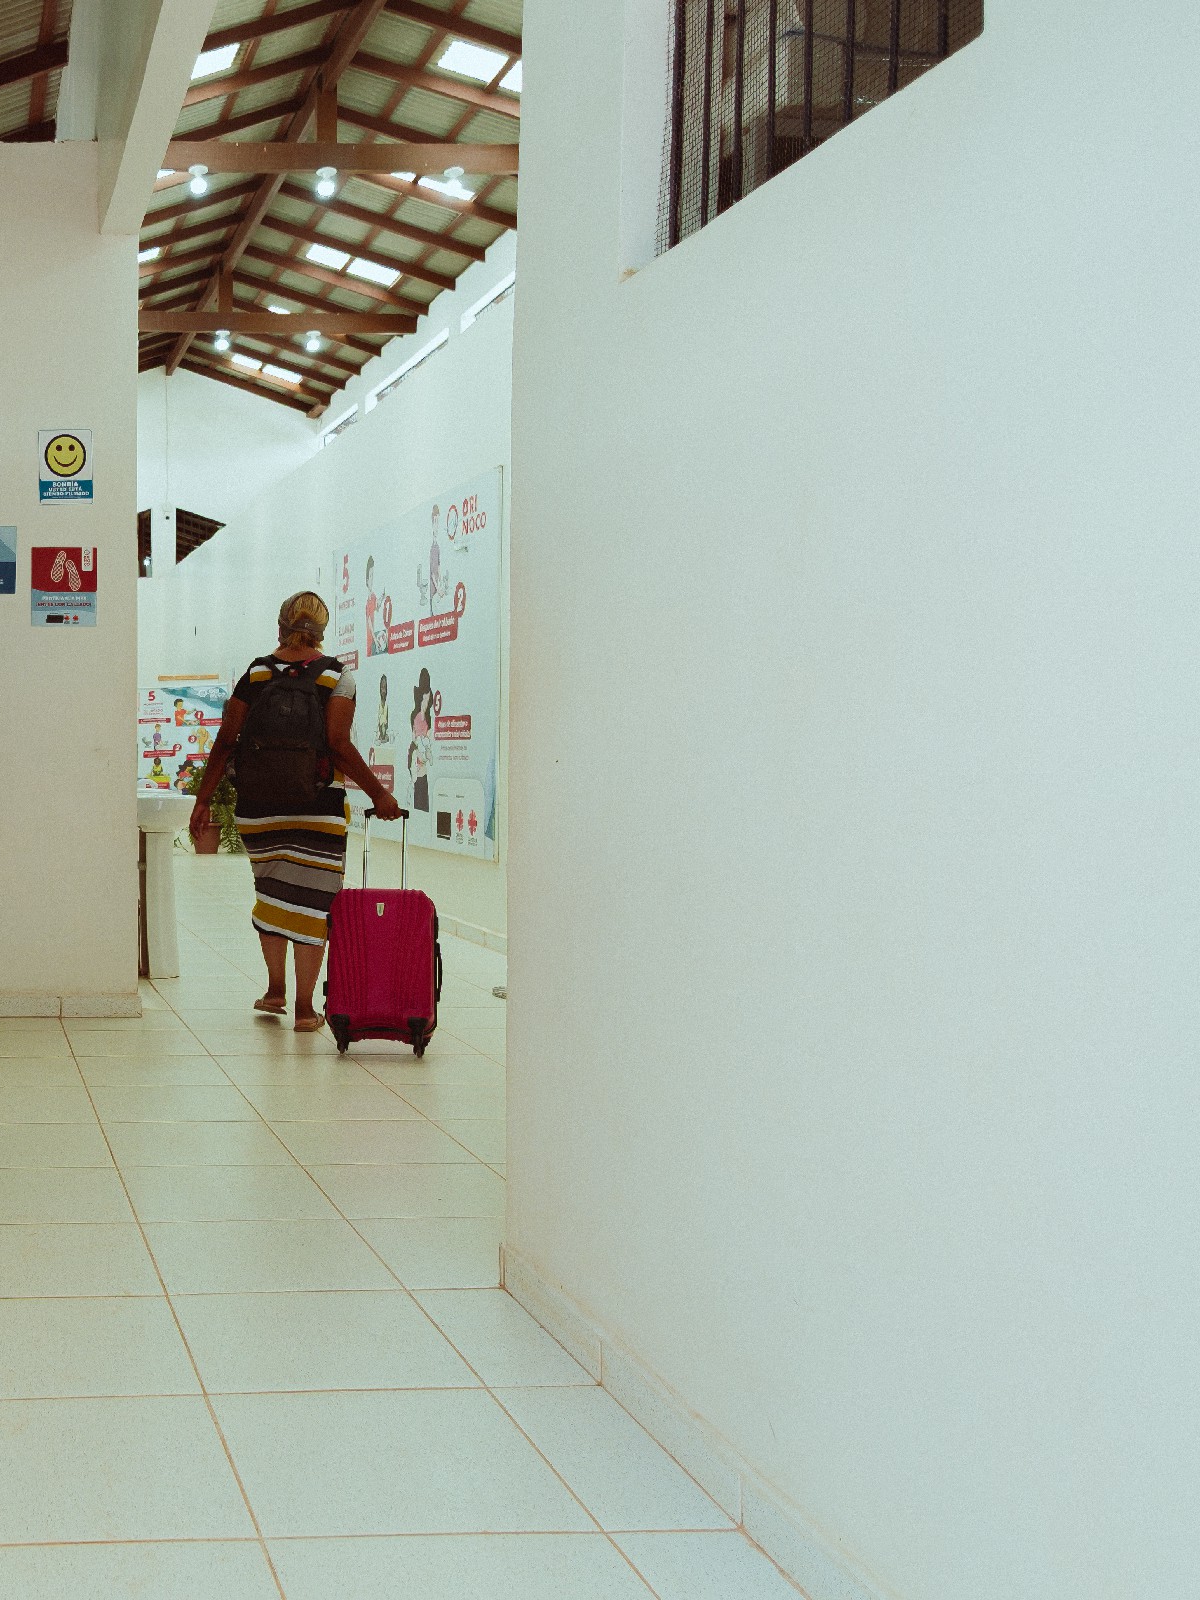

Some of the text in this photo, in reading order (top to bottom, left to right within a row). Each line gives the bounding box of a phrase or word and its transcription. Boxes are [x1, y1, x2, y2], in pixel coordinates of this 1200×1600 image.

[462, 494, 477, 517] ORI
[461, 511, 486, 536] NOCO
[435, 694, 441, 711] 5
